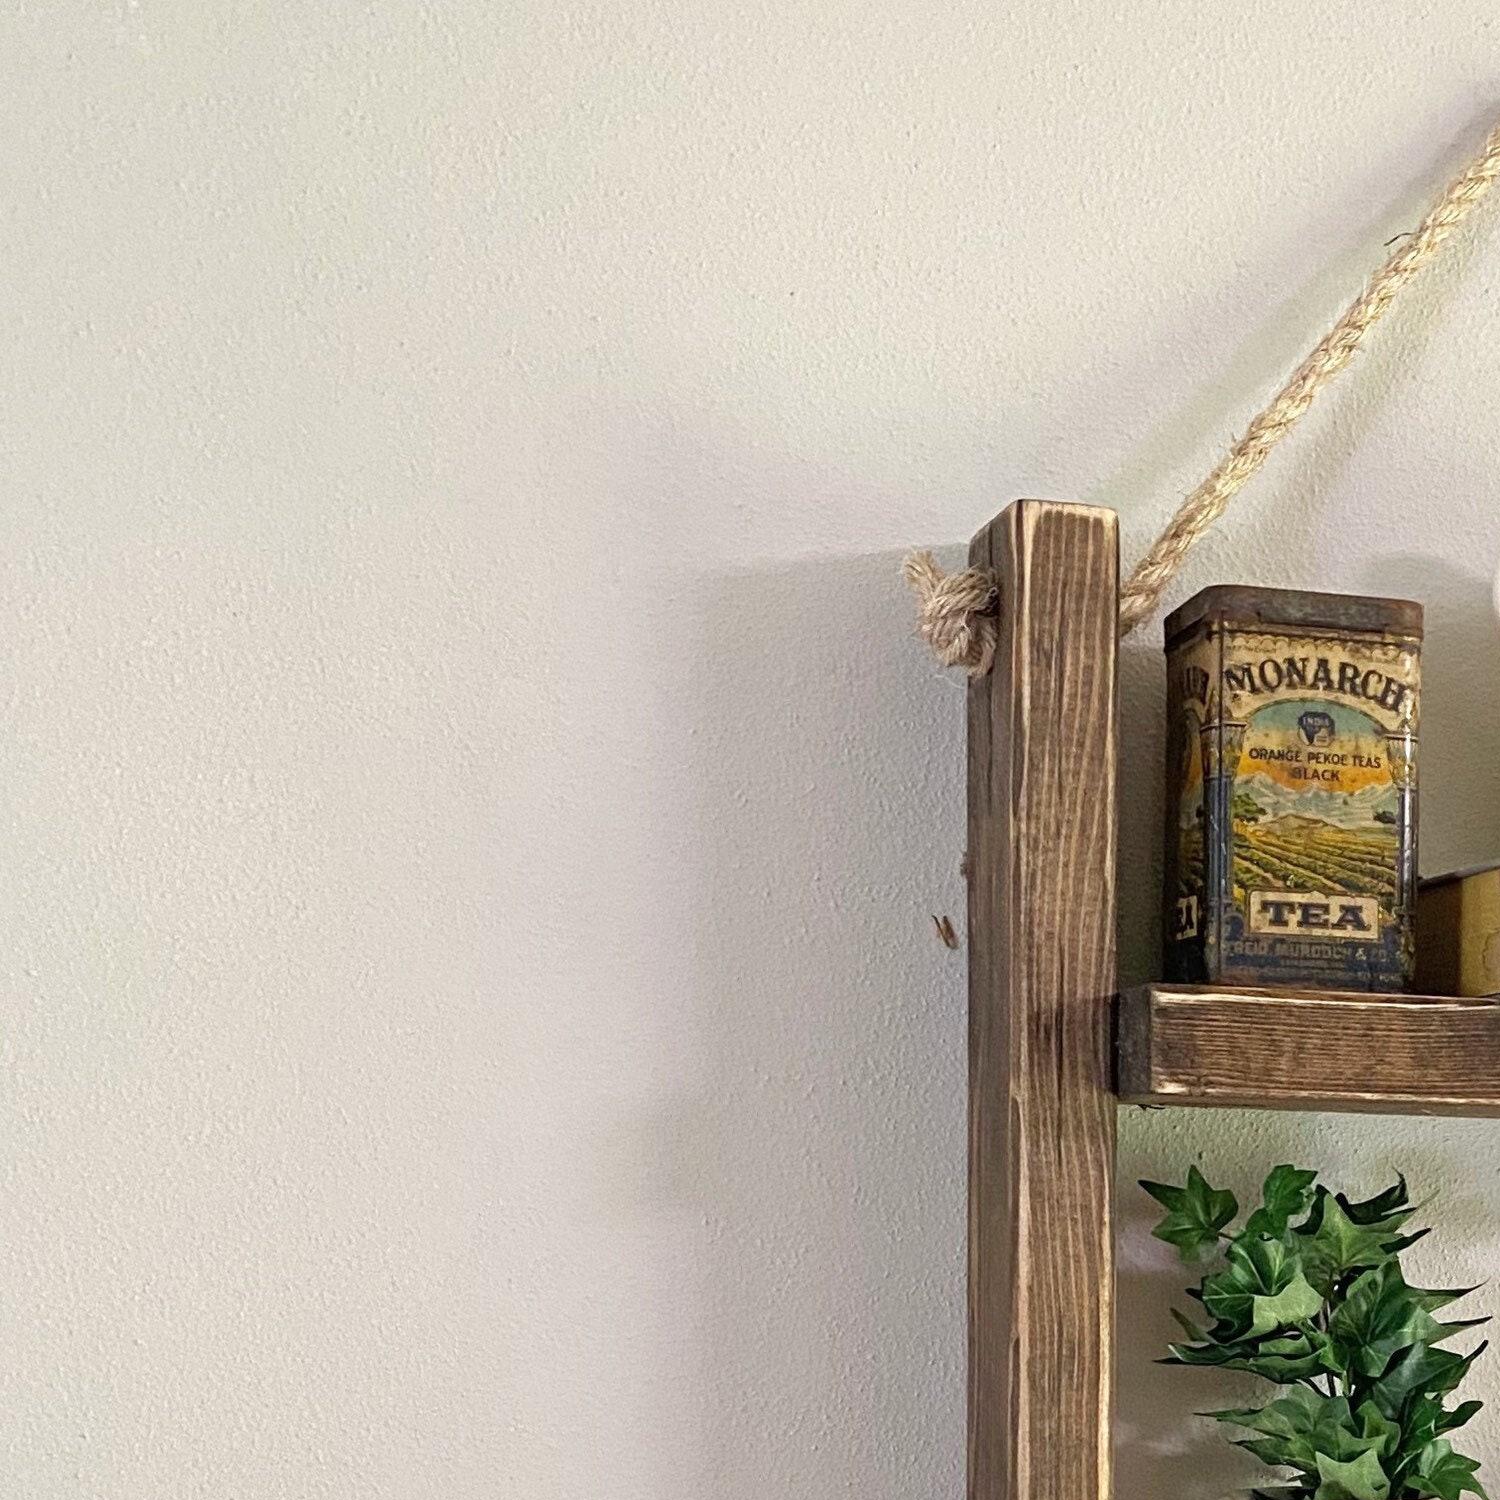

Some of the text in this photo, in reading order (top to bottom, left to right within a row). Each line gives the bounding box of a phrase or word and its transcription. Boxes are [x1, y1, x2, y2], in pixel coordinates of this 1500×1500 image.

[1223, 656, 1407, 712] MONARCH
[1249, 747, 1381, 768] ORANGE PEKOE TEAS
[1259, 900, 1372, 931] TEA
